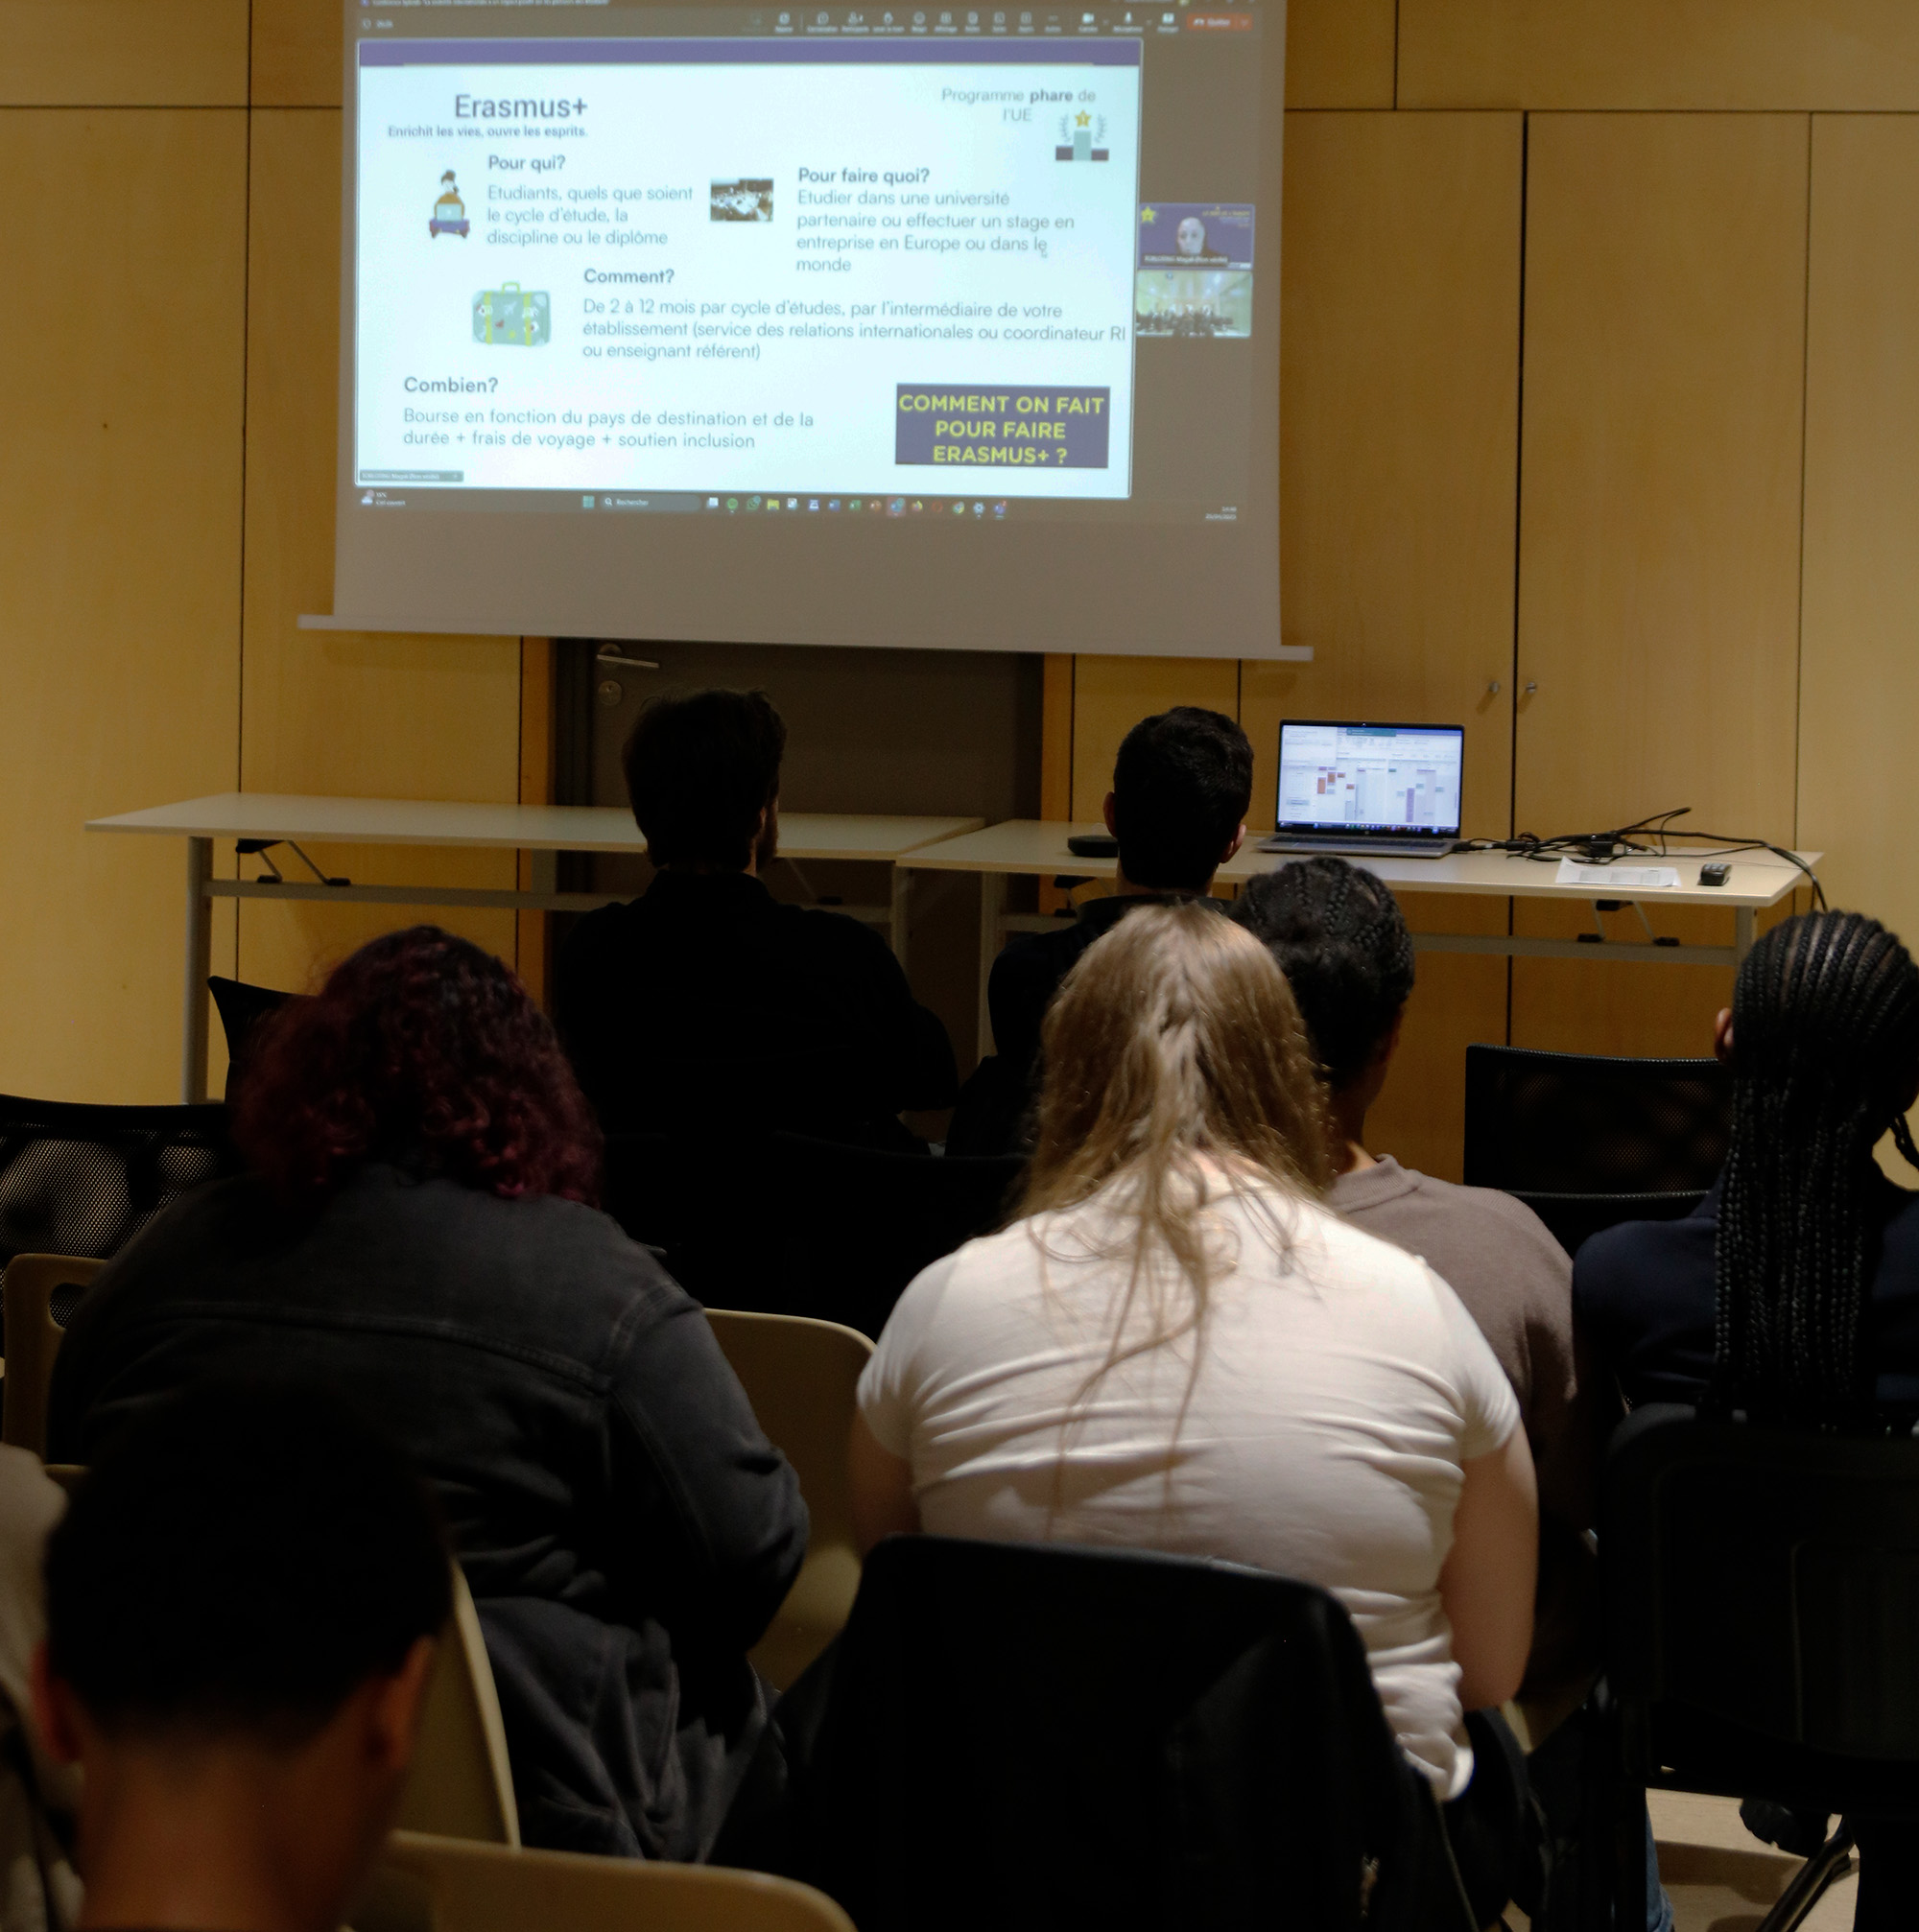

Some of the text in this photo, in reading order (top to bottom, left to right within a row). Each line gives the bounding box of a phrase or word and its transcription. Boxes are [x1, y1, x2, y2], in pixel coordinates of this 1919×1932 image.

[942, 88, 1096, 105] Programme phare de
[456, 94, 587, 118] Erasmus+
[389, 126, 433, 137] Enrichit
[437, 126, 454, 136] les
[458, 128, 484, 137] vies,
[524, 125, 540, 136] les
[544, 127, 588, 139] esprits.
[488, 154, 565, 174] Pour qui?
[799, 168, 930, 186] Pour faire quoi?
[488, 184, 693, 203] Etudiants, quels que soient
[798, 189, 1009, 205] Etudier dans une université
[487, 207, 500, 222] le
[505, 207, 544, 226] cycle
[616, 207, 628, 222] la
[797, 213, 1074, 232] partenaire ou effectuer un stage en
[487, 229, 668, 247] discipline ou le diplôme
[797, 235, 1047, 253] entreprise en Europe ou dans le
[796, 257, 851, 271] monde
[584, 269, 675, 283] Comment?
[584, 298, 604, 313] De
[610, 298, 620, 314] 2
[625, 300, 633, 314] à
[640, 298, 654, 314] 12
[660, 300, 696, 314] mois
[700, 303, 725, 317] par
[731, 300, 770, 318] cycle
[851, 305, 876, 318] par
[998, 302, 1017, 317] de
[1023, 305, 1062, 318] votre
[583, 321, 1125, 341] établissement (service des relations internationales ou coordinateur RI
[583, 343, 760, 361] ou enseignant référent)
[404, 377, 498, 392] Combien?
[899, 395, 1103, 413] COMMENT ON FAIT
[404, 408, 814, 428] Bourse en fonction du pays de destination et de la
[936, 420, 1064, 438] POUR FAIRE
[404, 431, 449, 444] durée
[473, 430, 506, 445] frais
[511, 431, 532, 445] de
[538, 435, 595, 450] voyage
[619, 433, 676, 447] soutien
[684, 433, 754, 448] inclusion
[934, 446, 1067, 463] ERASMUS+ ?
[616, 499, 649, 507] Rechercher
